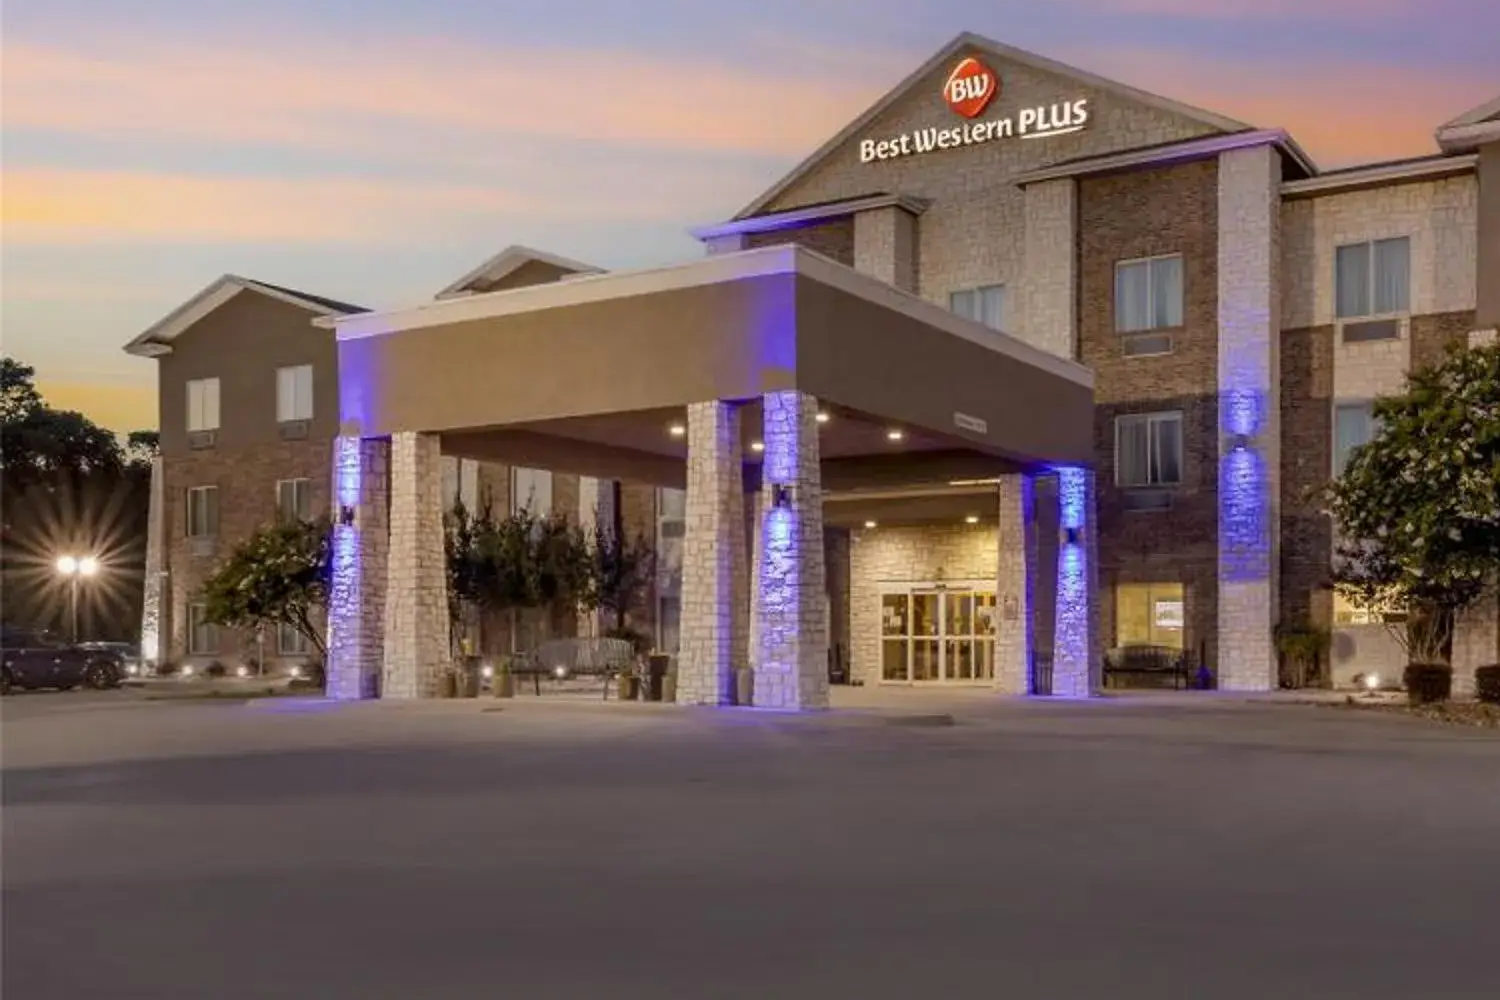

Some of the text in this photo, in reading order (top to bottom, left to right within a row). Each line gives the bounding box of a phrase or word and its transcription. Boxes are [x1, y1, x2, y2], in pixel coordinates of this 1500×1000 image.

[951, 74, 989, 103] BW
[860, 100, 1087, 163] Best Western PLUS
